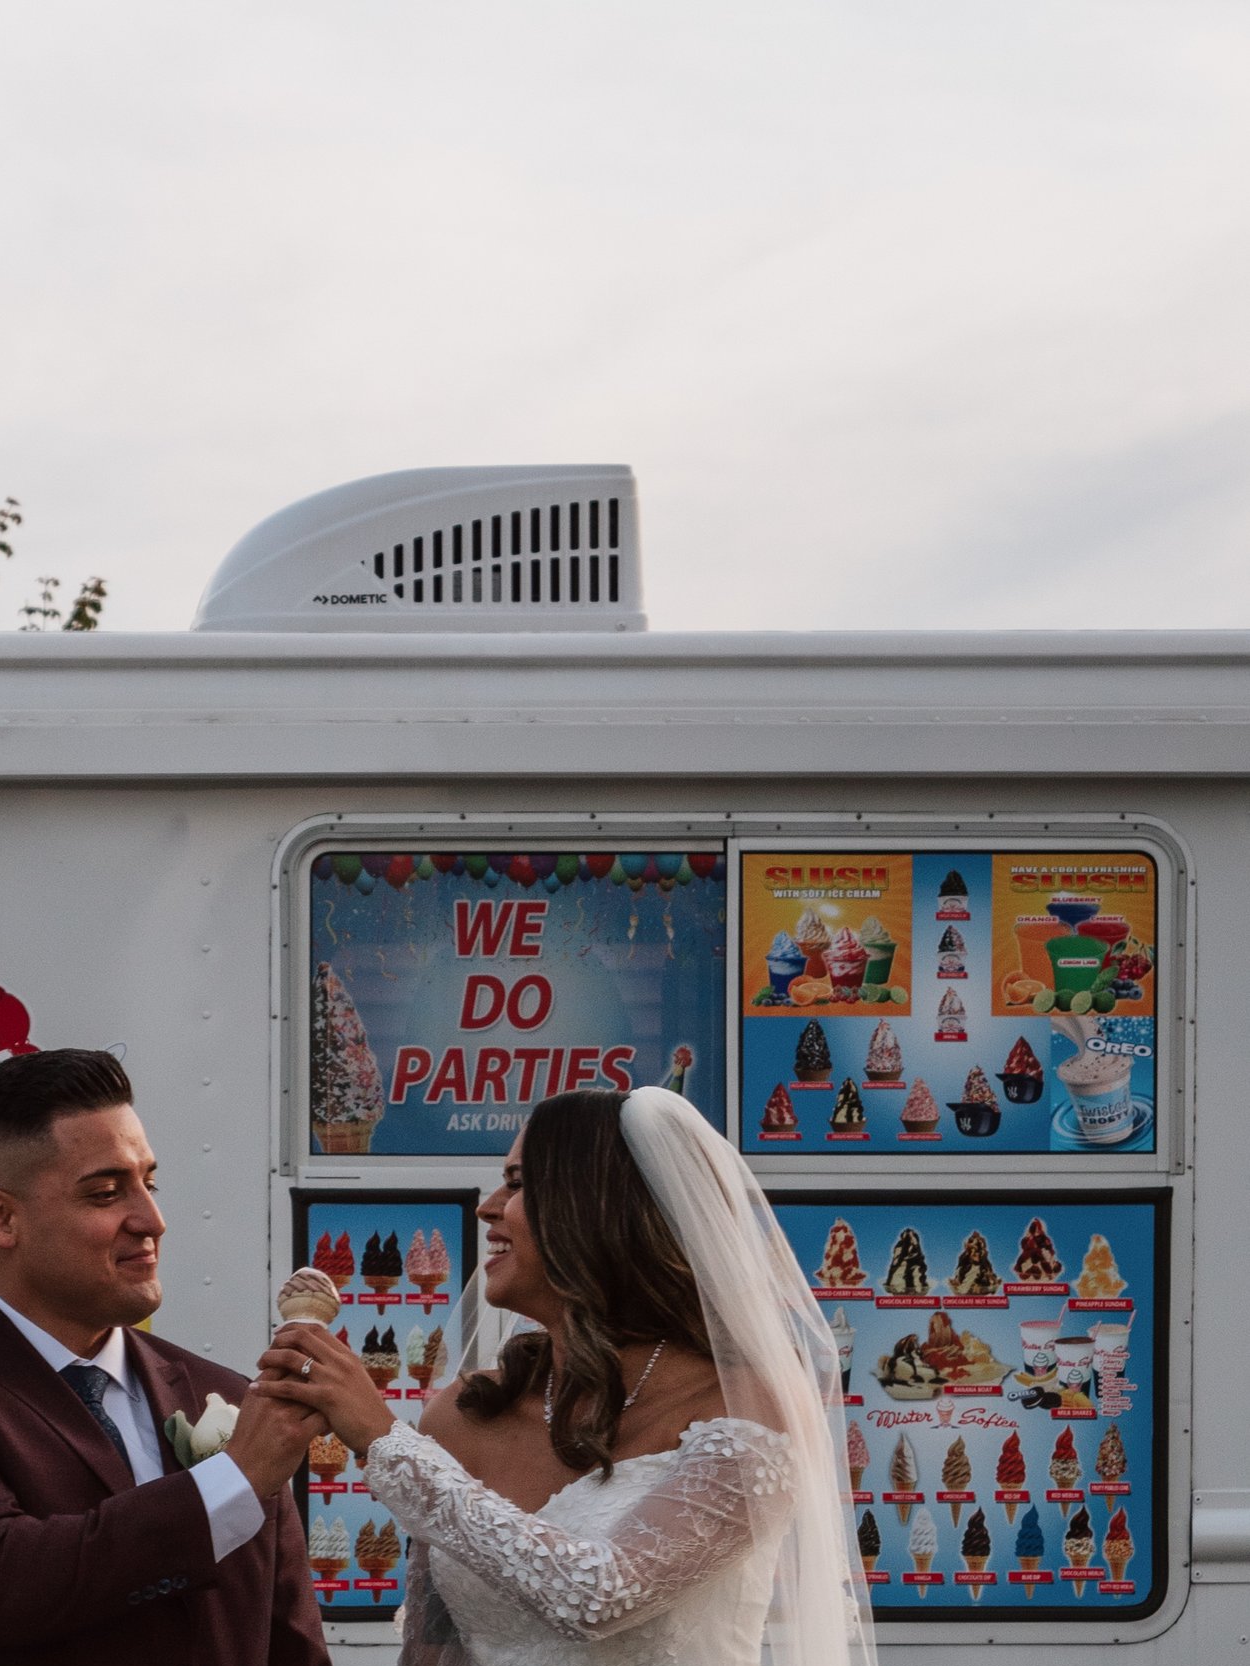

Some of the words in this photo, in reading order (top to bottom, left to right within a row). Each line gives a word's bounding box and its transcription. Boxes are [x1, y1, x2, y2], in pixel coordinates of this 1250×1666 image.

[330, 593, 387, 605] DOMETIC
[764, 866, 888, 890] SLUSH
[1011, 873, 1147, 893] SLUSH
[774, 890, 799, 898] WITH
[802, 890, 825, 898] SOFT
[828, 890, 844, 898] ICE
[846, 890, 881, 898] CREAM
[452, 899, 550, 959] WE
[458, 974, 554, 1032] DO
[1086, 1037, 1153, 1057] OREO
[388, 1046, 637, 1105] PARTIES
[446, 1113, 483, 1132] ASK
[867, 1410, 933, 1428] Mister
[958, 1408, 1020, 1428] Softee
